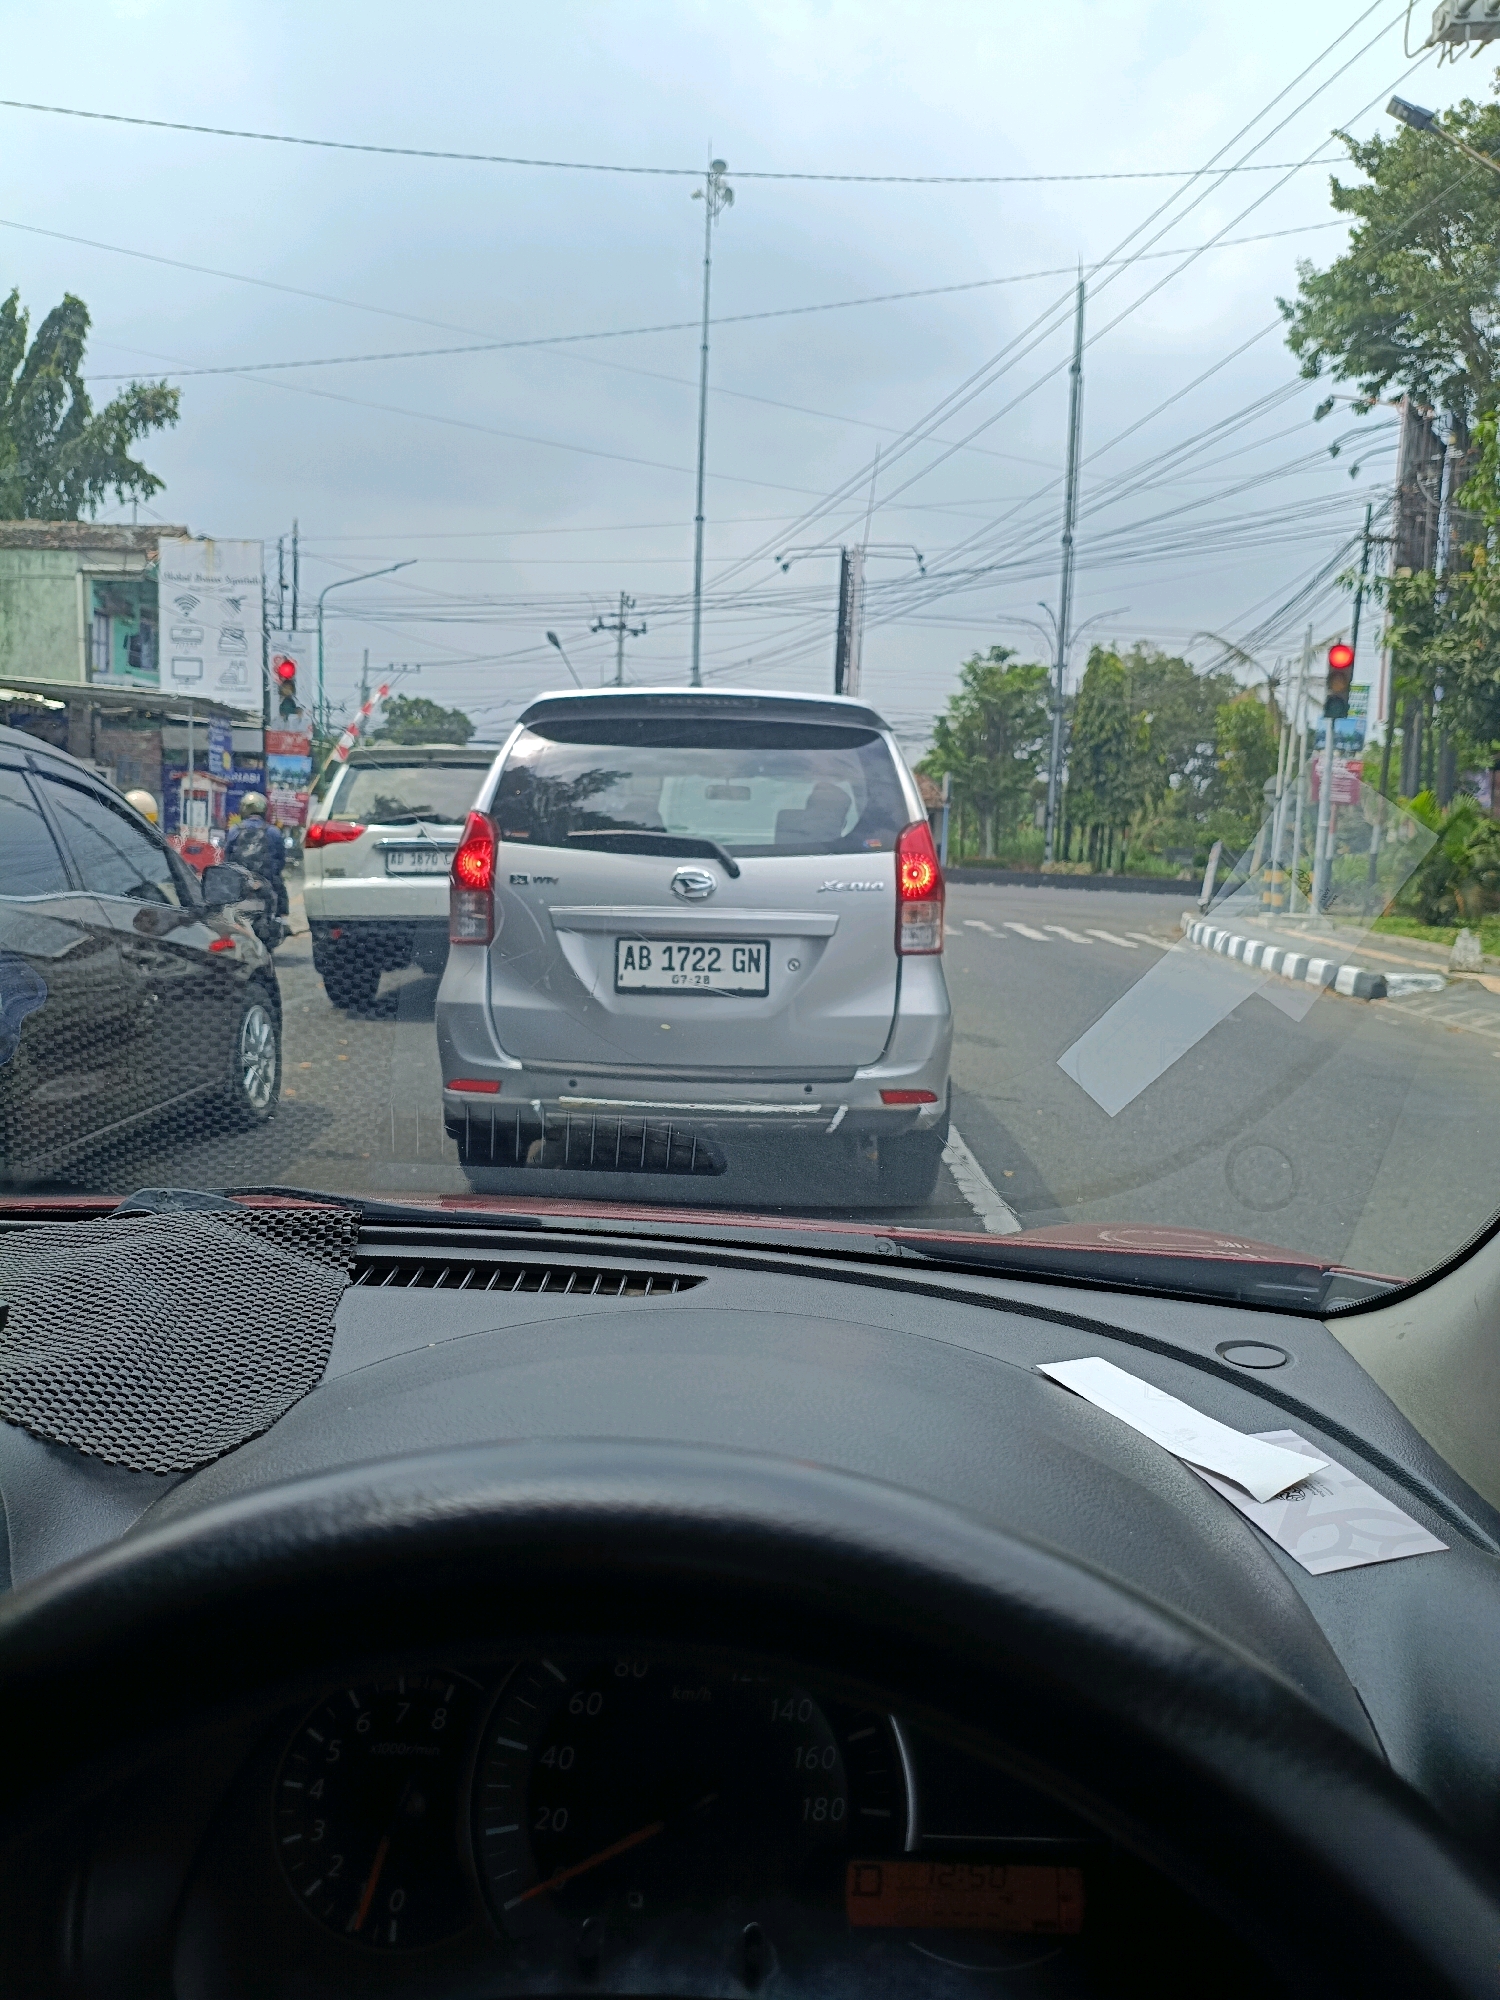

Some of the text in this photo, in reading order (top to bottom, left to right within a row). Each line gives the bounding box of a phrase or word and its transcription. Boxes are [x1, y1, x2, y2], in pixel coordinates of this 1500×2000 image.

[624, 945, 761, 973] AB 1722 GN
[569, 1691, 603, 1716] 60
[671, 1685, 712, 1702] km/h
[356, 1711, 371, 1733] 6
[395, 1702, 410, 1724] 7
[431, 1708, 447, 1730] 8
[771, 1697, 813, 1723] 140
[326, 1739, 342, 1763] 5
[540, 1746, 575, 1770] 40
[794, 1745, 836, 1769] 160
[309, 1778, 325, 1800] 4
[534, 1807, 568, 1832] 20
[803, 1798, 845, 1821] 180
[310, 1819, 326, 1841] 3
[327, 1853, 344, 1878] 2
[388, 1888, 406, 1913] 0
